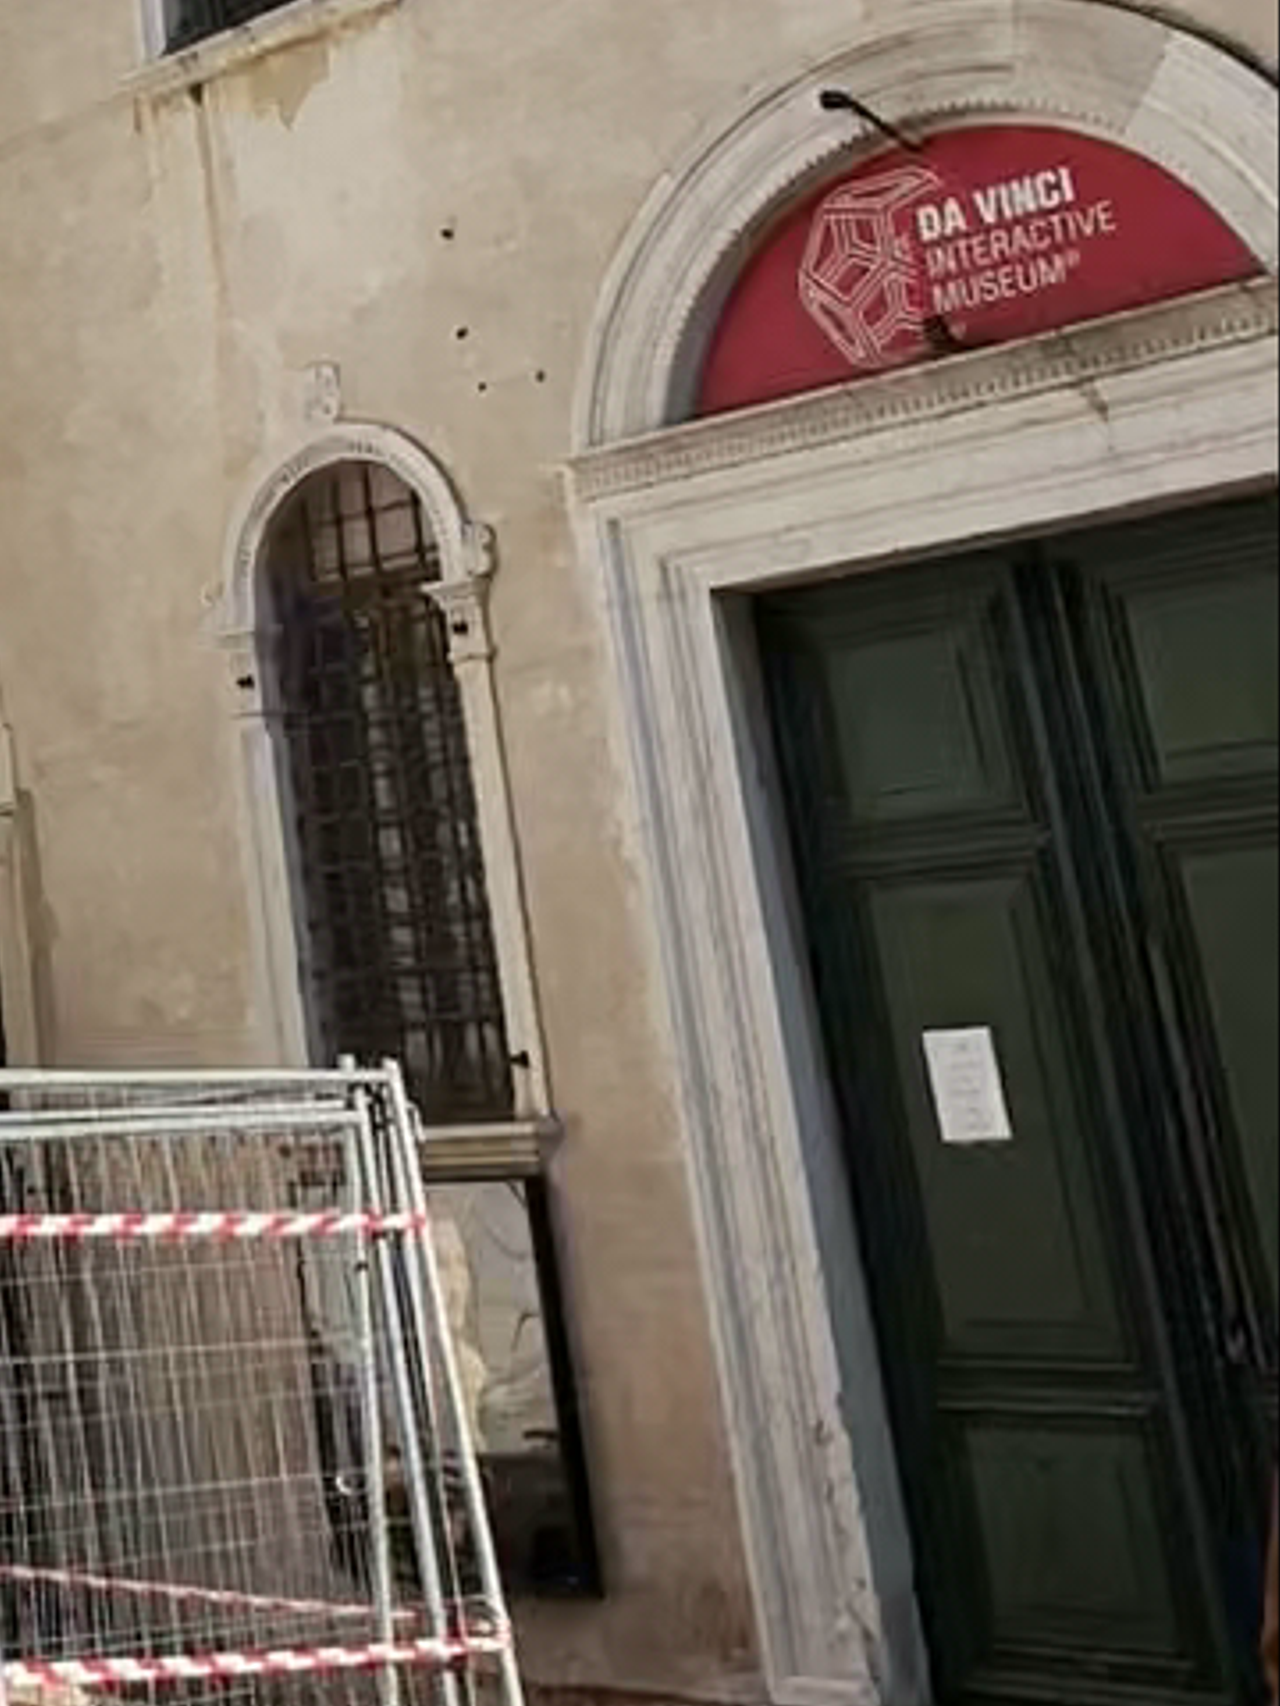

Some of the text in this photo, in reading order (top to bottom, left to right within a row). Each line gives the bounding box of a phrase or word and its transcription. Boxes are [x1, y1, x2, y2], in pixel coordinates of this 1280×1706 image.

[916, 167, 1074, 242] DA VINCI
[925, 201, 1117, 278] INTERACTIVE
